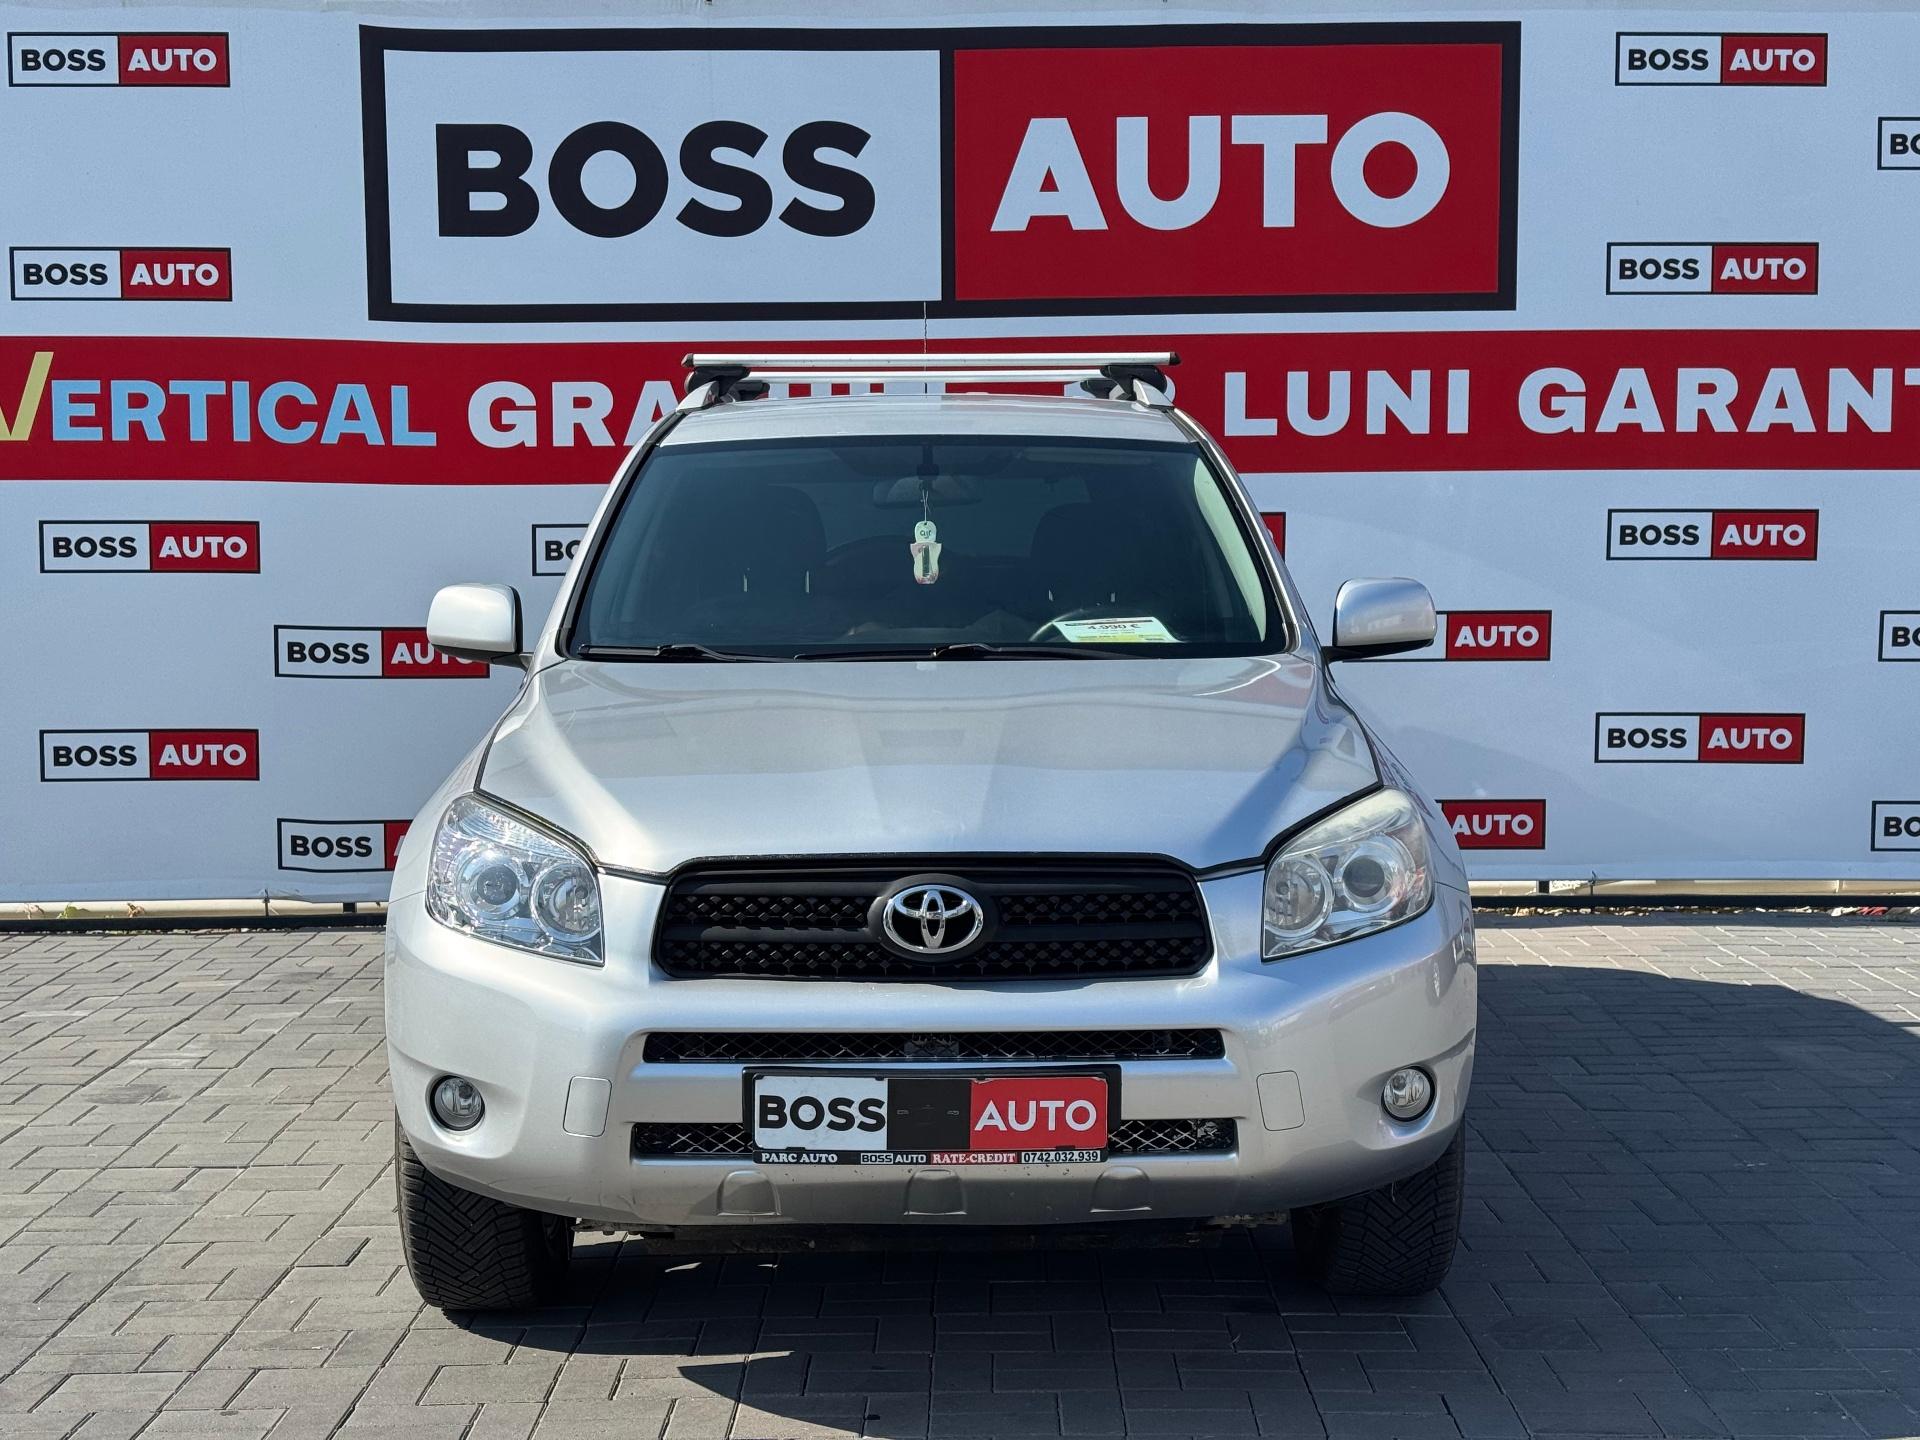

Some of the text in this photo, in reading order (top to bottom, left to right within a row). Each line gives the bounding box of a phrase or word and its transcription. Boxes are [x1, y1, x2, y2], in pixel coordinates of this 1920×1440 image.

[22, 49, 216, 71] BOSS AUTO
[1629, 49, 1815, 71] BOSS AUTO
[436, 112, 1450, 238] BOSS AUTO
[24, 264, 219, 286] BOSS AUTO
[1620, 258, 1806, 280] BOSS AUTO
[1225, 369, 1469, 436] LUNI
[1519, 368, 1920, 434] GARAN
[1620, 525, 1805, 546] BOSS AUTO
[53, 537, 247, 558] BOSS AUTO
[545, 540, 581, 561] BO
[1455, 626, 1539, 647] AUTO
[288, 642, 369, 664] BOSS
[1608, 728, 1792, 749] BOSS AUTO
[53, 744, 246, 766] BOSS AUTO
[1452, 814, 1533, 835] AUTO
[291, 835, 372, 858] BOSS
[759, 1095, 1097, 1132] BOSS AUTO
[761, 1151, 1098, 1164] PARC AUTO BOSS AUTO RATE-CREDIT 0742.032.939
